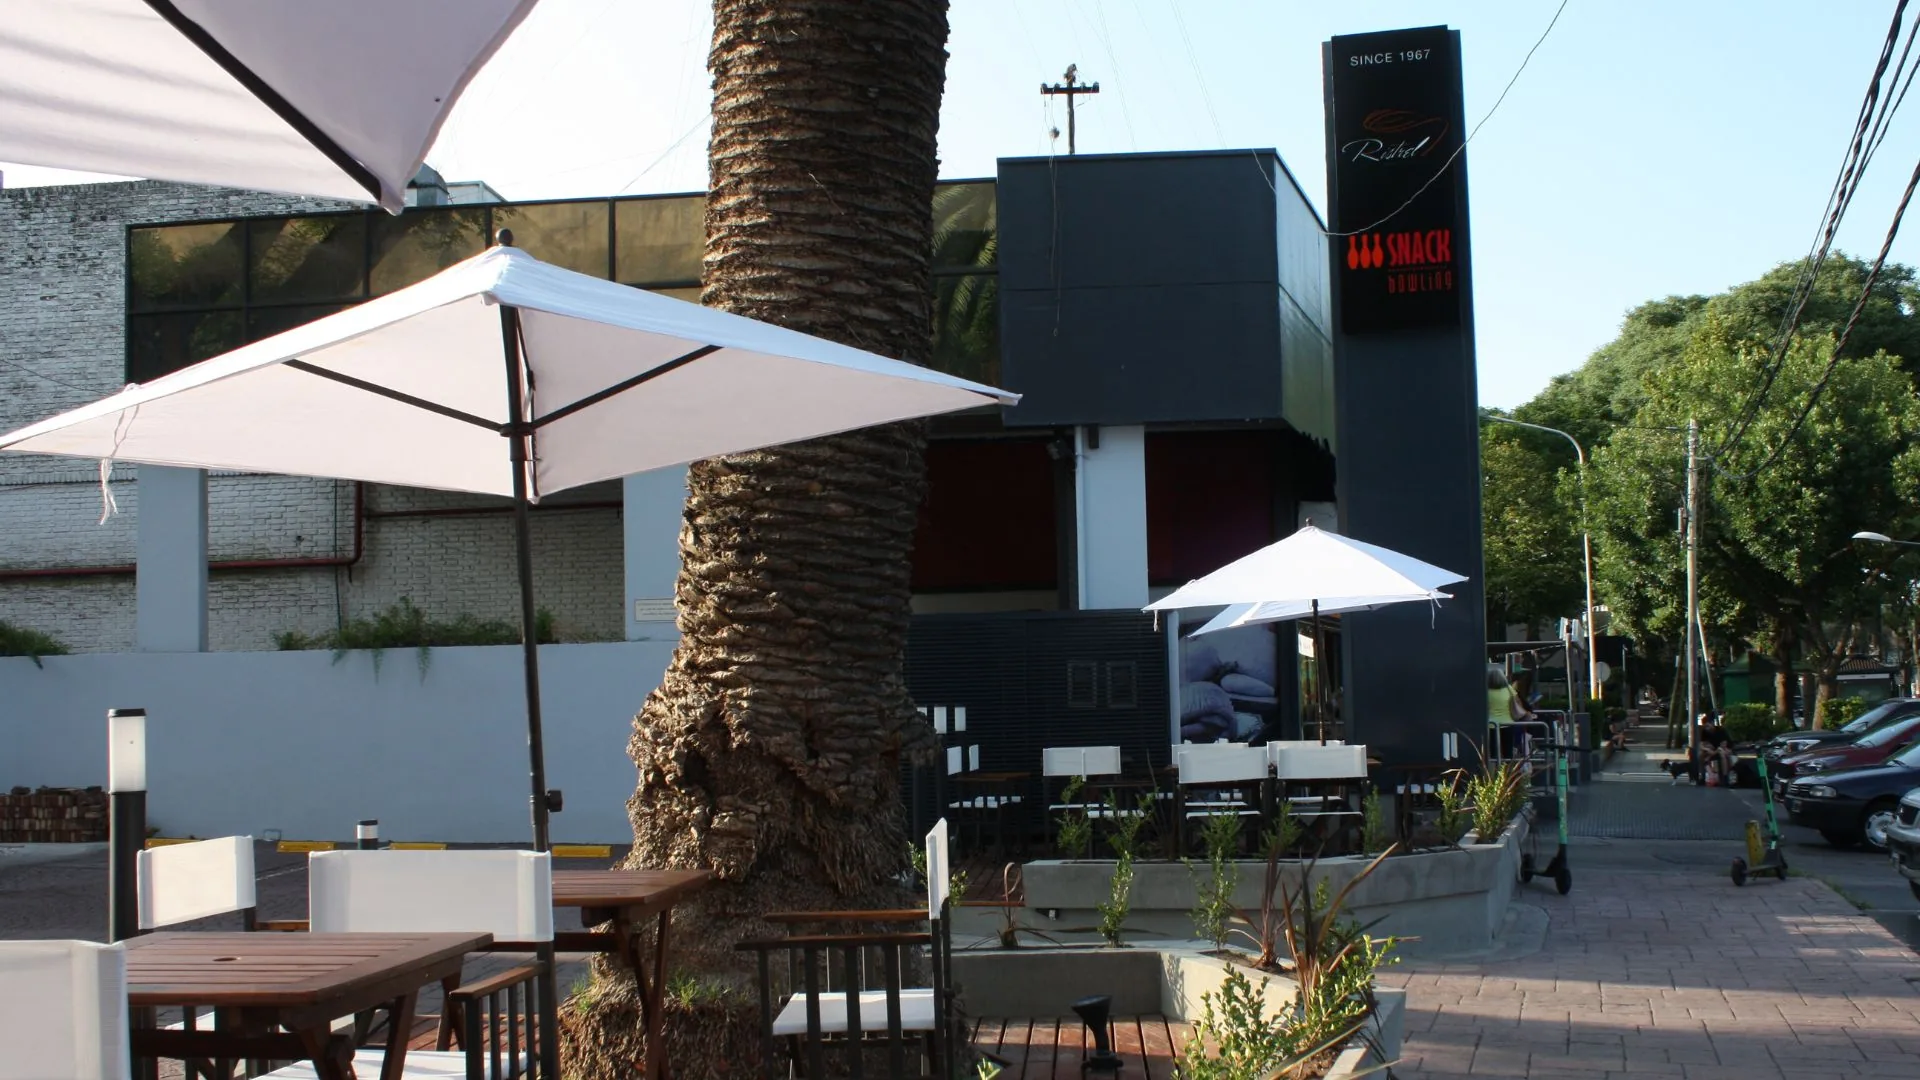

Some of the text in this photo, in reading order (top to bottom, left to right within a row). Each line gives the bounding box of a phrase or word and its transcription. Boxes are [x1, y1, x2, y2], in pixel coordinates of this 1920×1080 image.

[1350, 48, 1431, 67] SINCE 1967
[1386, 229, 1451, 267] SNACK
